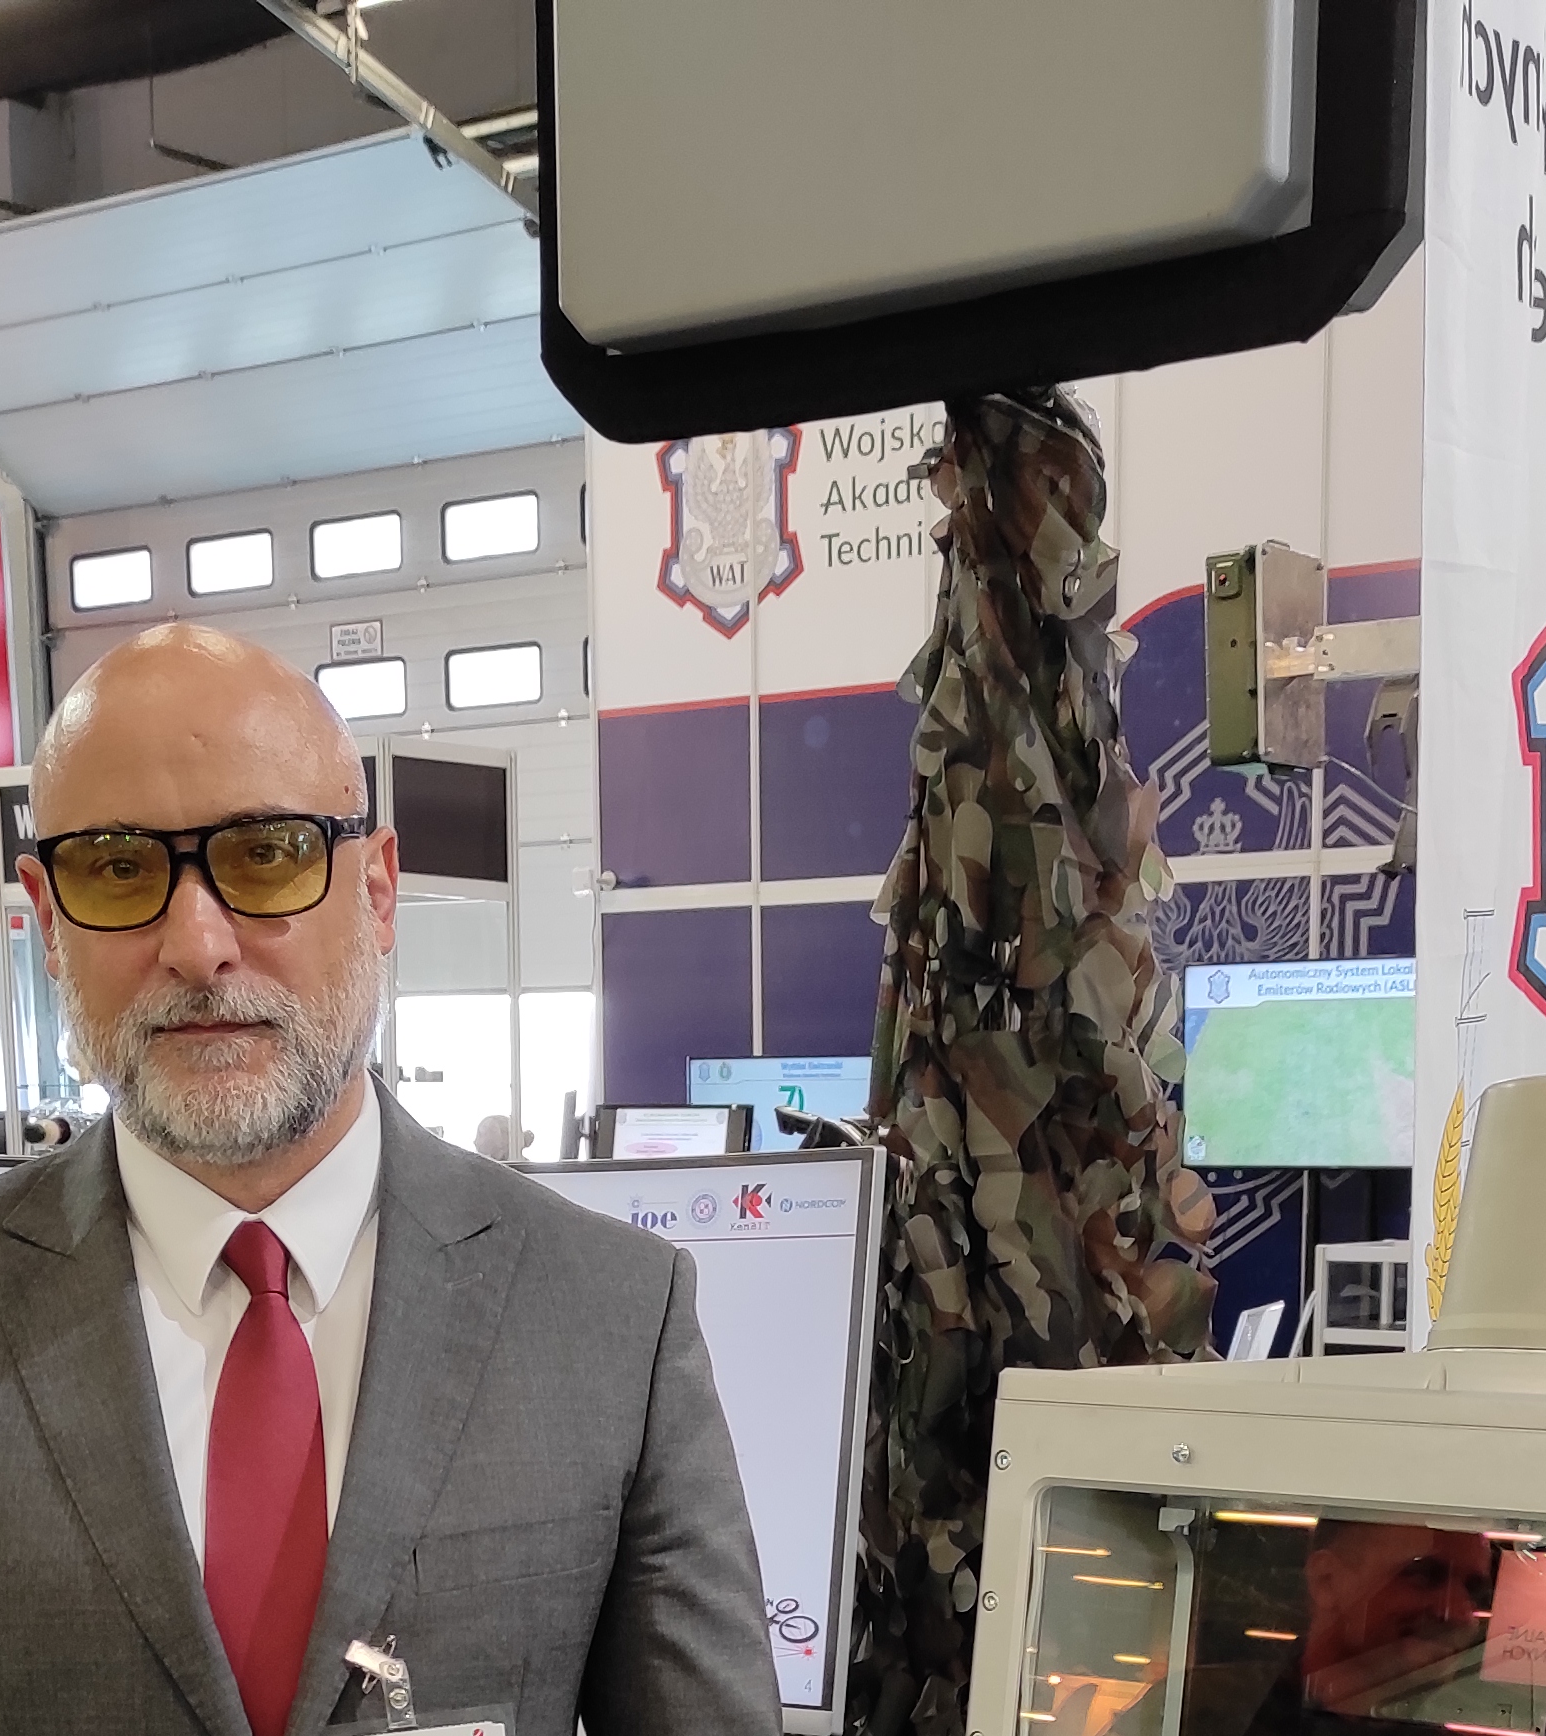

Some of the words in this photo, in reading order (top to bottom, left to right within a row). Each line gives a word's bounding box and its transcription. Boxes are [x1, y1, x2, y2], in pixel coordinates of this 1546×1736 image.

[710, 561, 748, 587] WAT
[1248, 966, 1332, 981] Autonomiczny
[1336, 965, 1379, 979] System
[1257, 982, 1313, 996] Emiterów
[1317, 981, 1381, 995] Radiowych
